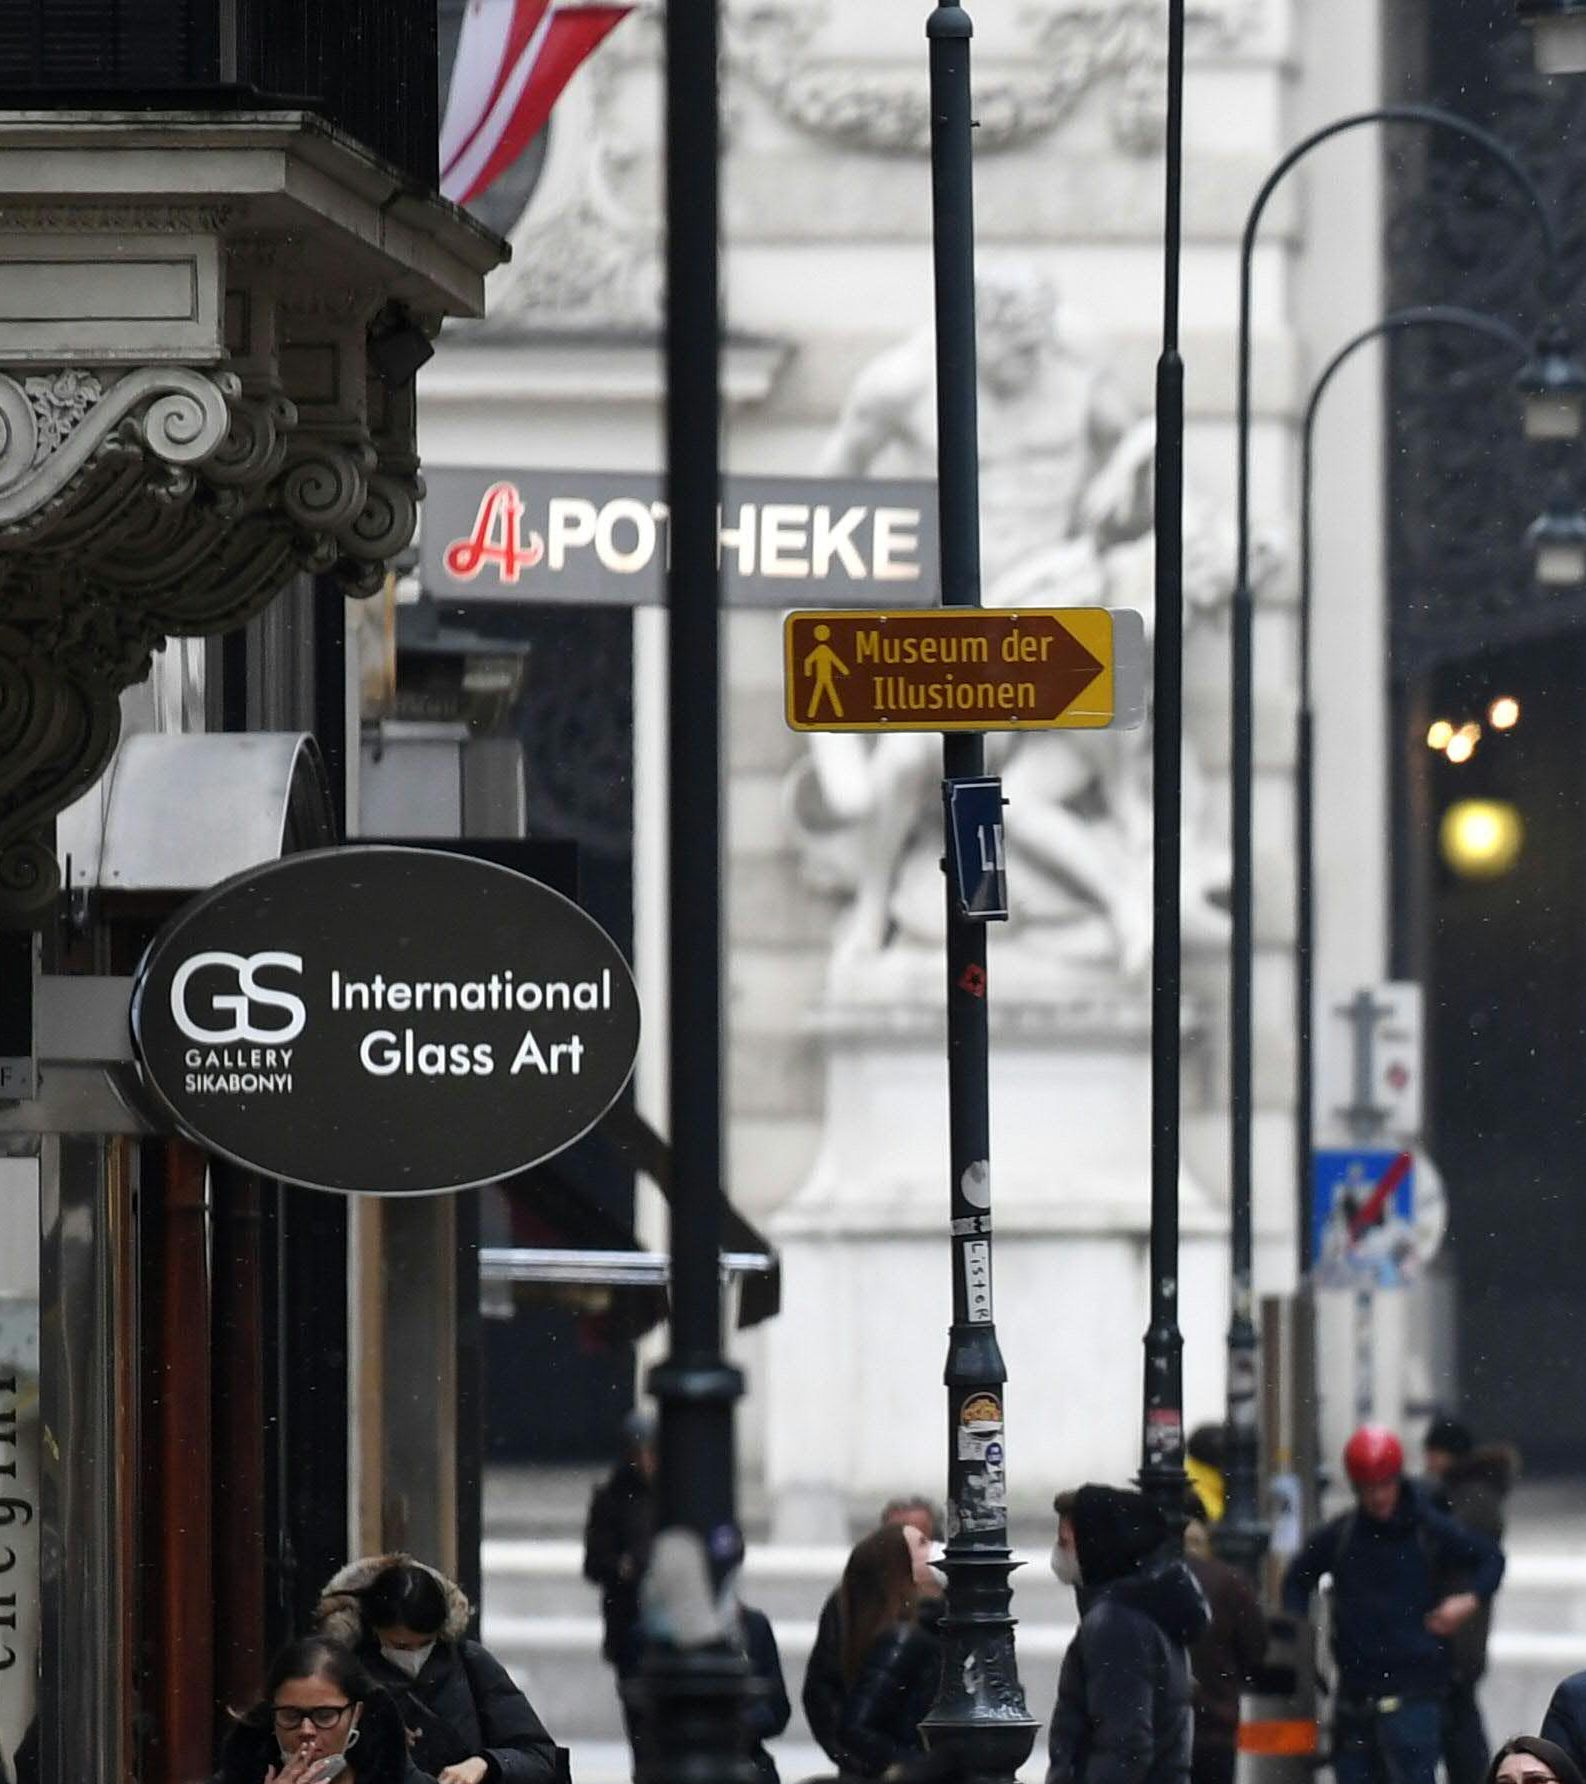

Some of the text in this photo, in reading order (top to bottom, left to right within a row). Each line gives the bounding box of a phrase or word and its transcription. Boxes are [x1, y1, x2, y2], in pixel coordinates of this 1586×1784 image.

[855, 628, 1054, 664] Museum der
[873, 673, 1036, 710] Illusionen
[170, 951, 307, 1044] GS
[331, 968, 611, 1011] International
[185, 1048, 294, 1069] GALLERY
[359, 1028, 583, 1076] Glass Art
[185, 1073, 293, 1094] SIKABONYI
